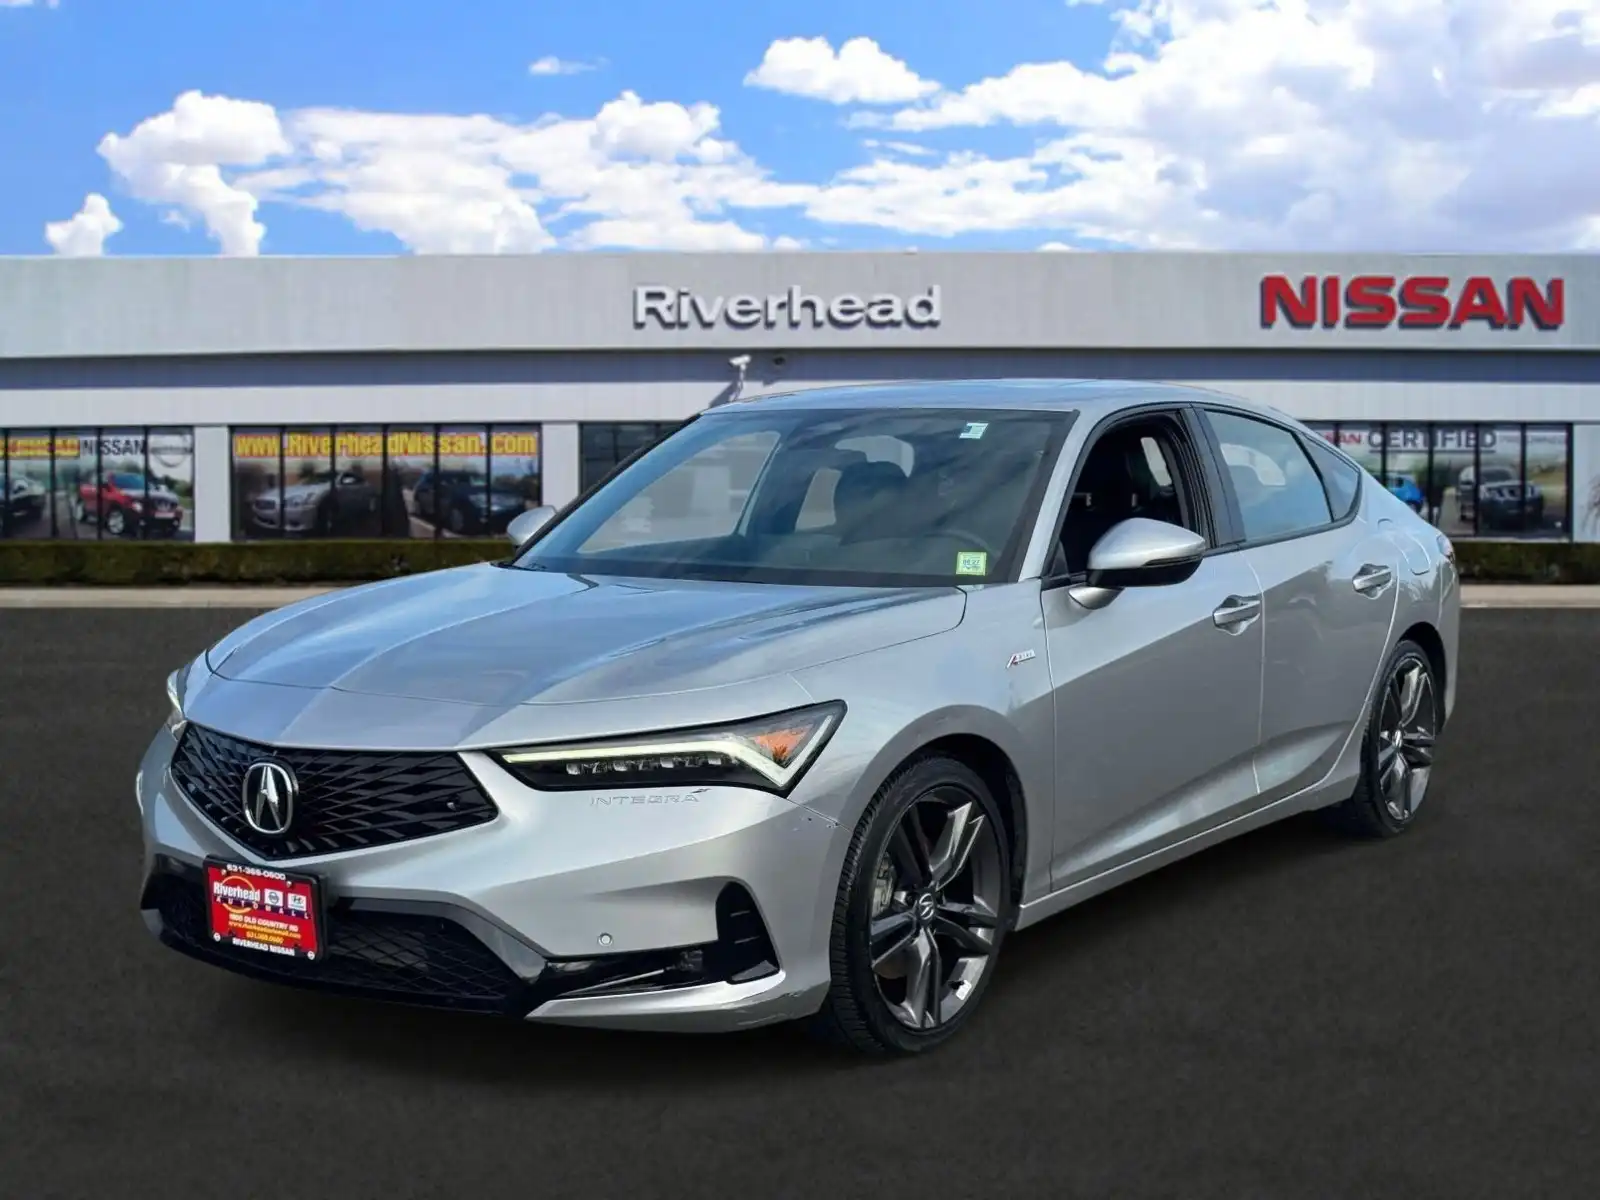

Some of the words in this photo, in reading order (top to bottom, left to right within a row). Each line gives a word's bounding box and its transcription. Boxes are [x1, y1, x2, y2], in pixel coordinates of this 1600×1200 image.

[633, 284, 941, 330] Riverhead
[1260, 275, 1565, 330] NISSAN
[83, 439, 148, 456] NSSAN
[1368, 429, 1497, 448] CERTIFIED
[590, 794, 700, 806] INTEGRA
[213, 881, 260, 902] Riverhead
[244, 915, 257, 924] OLD
[257, 917, 289, 930] COUNTRY
[289, 924, 299, 932] RD
[232, 937, 269, 951] RIVERHEAD
[269, 944, 295, 956] NISSAN
